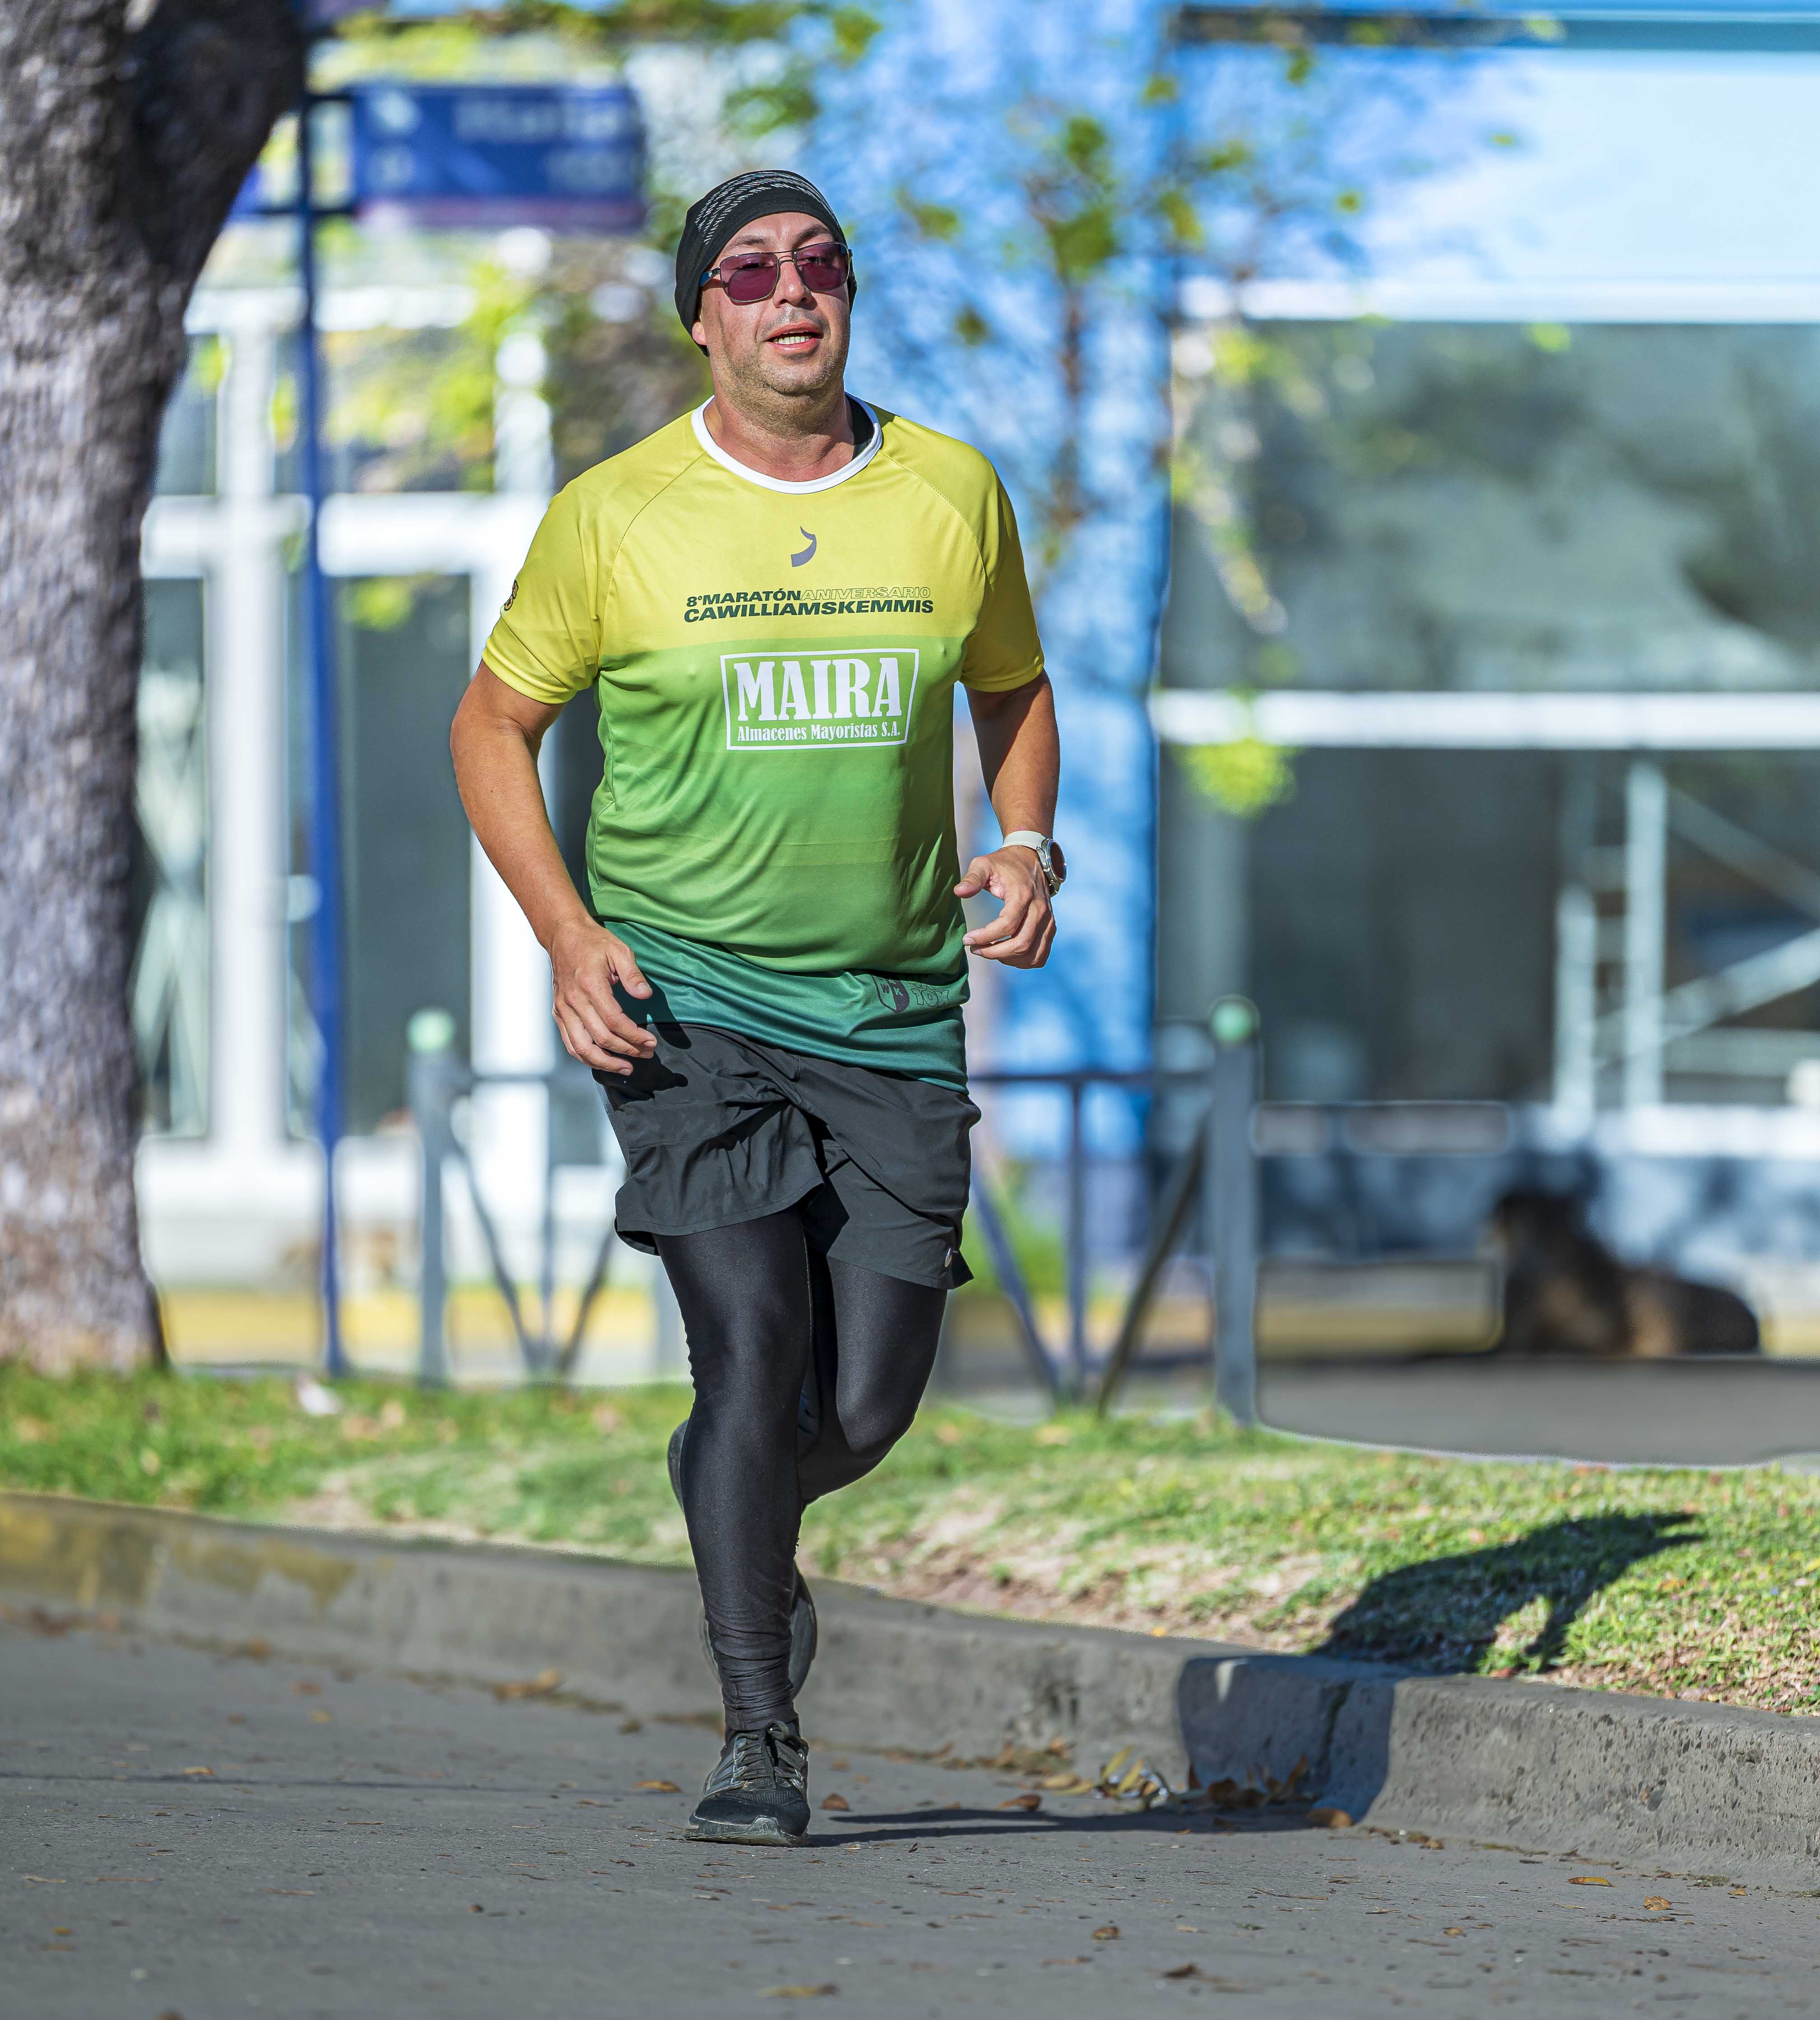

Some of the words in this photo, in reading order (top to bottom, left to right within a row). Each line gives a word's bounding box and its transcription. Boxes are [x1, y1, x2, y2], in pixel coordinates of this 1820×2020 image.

[684, 600, 934, 623] CAWILLIAMSKEMMIS
[734, 657, 902, 722] MAIRA
[737, 726, 807, 741] Almacenes
[810, 723, 878, 742] Mayoristas
[881, 721, 901, 737] S.A.
